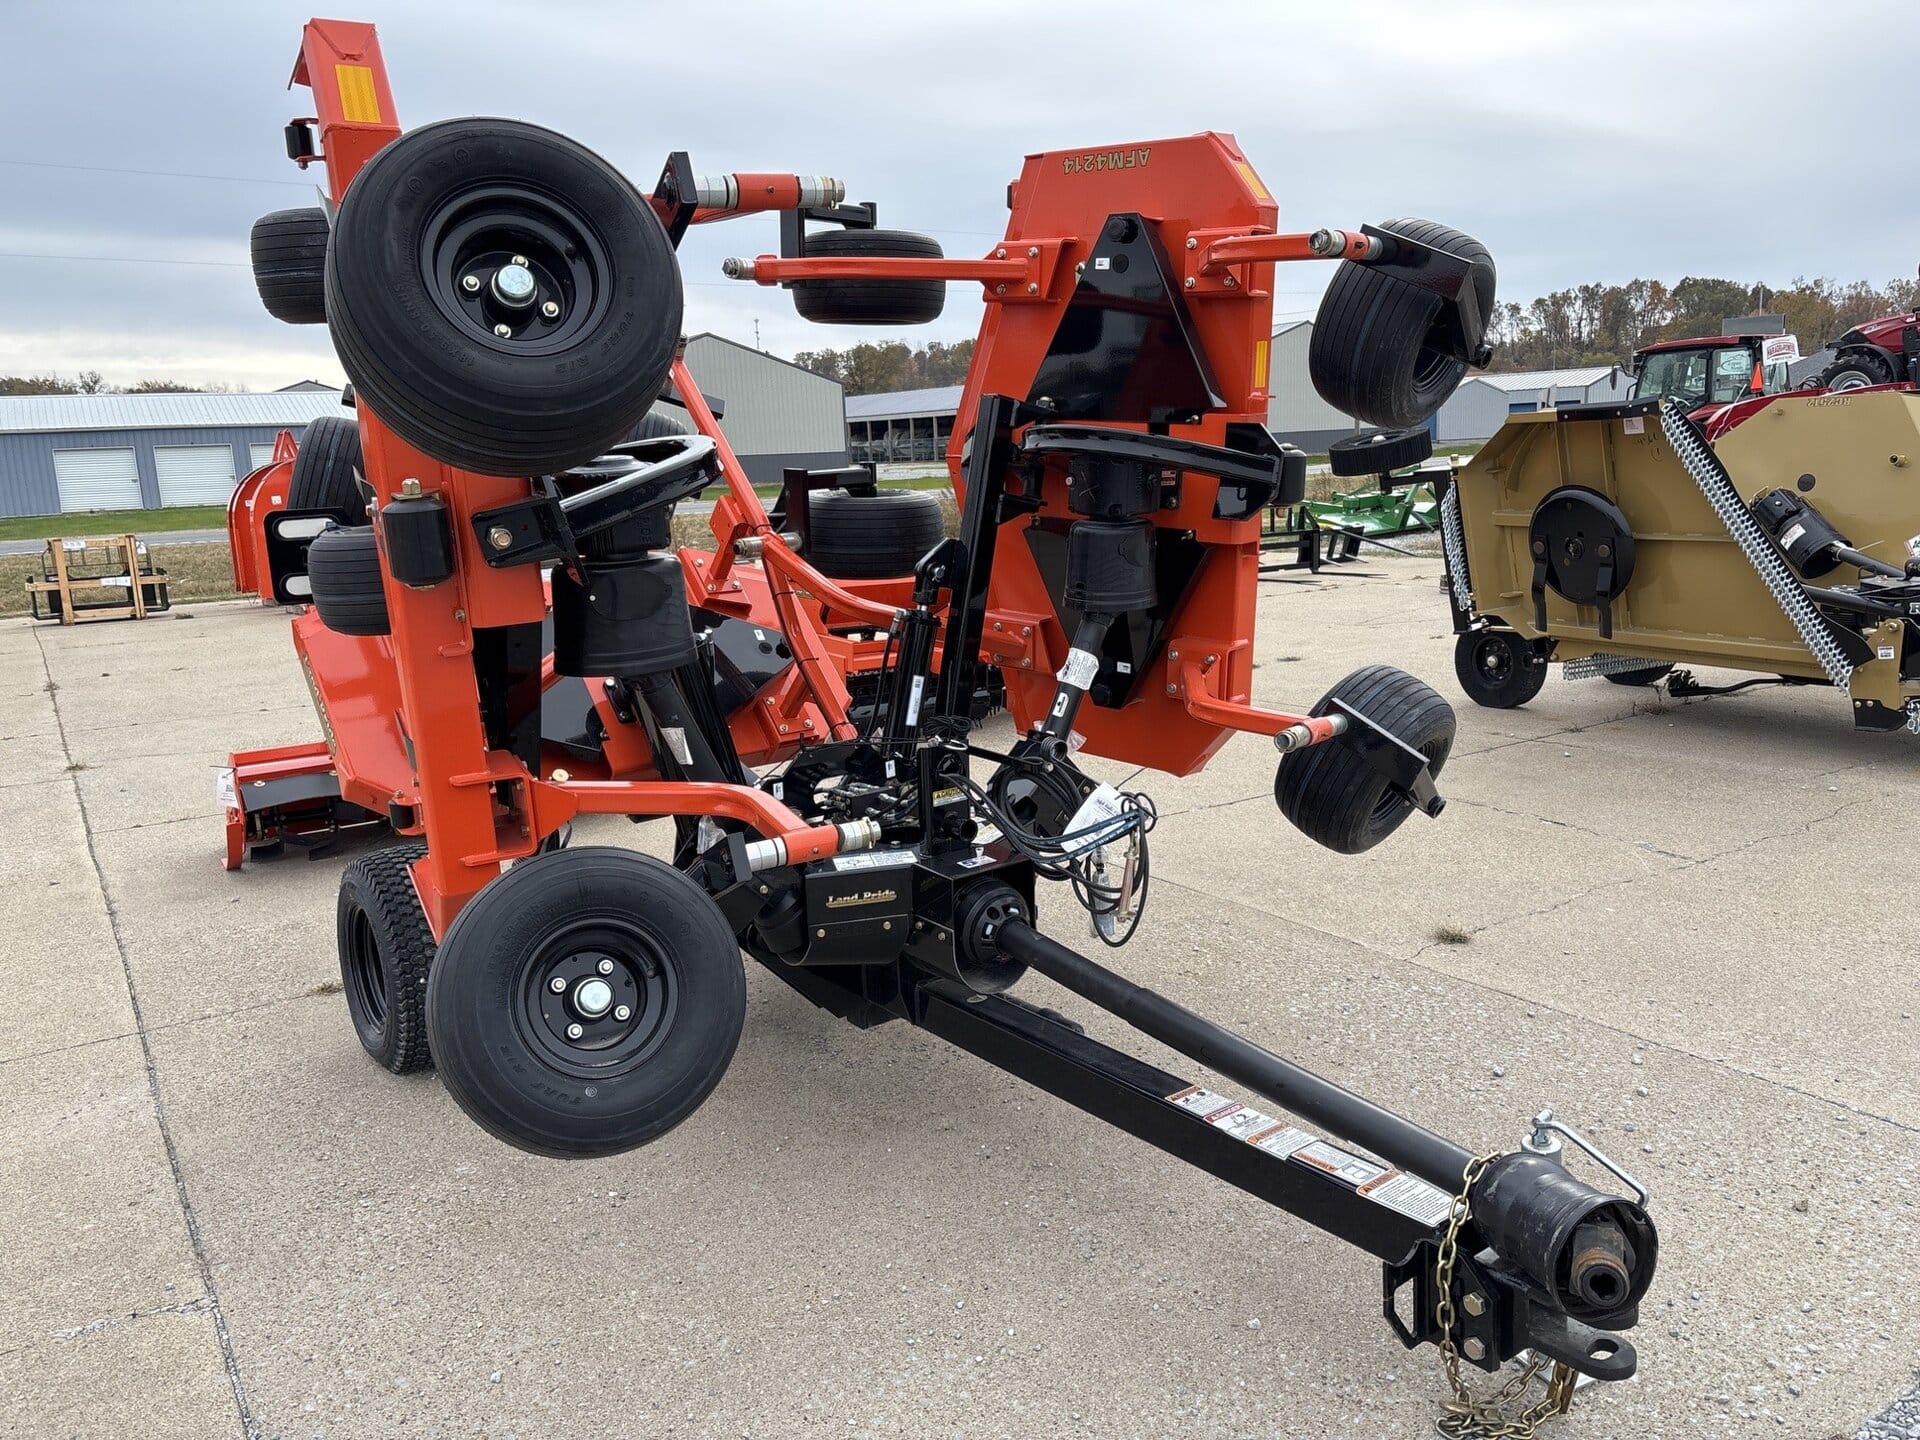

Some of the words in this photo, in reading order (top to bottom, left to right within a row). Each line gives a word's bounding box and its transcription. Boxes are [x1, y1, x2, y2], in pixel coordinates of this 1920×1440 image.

[1063, 148, 1151, 175] AFM4214
[828, 892, 859, 904] Land
[863, 889, 896, 900] Pride
